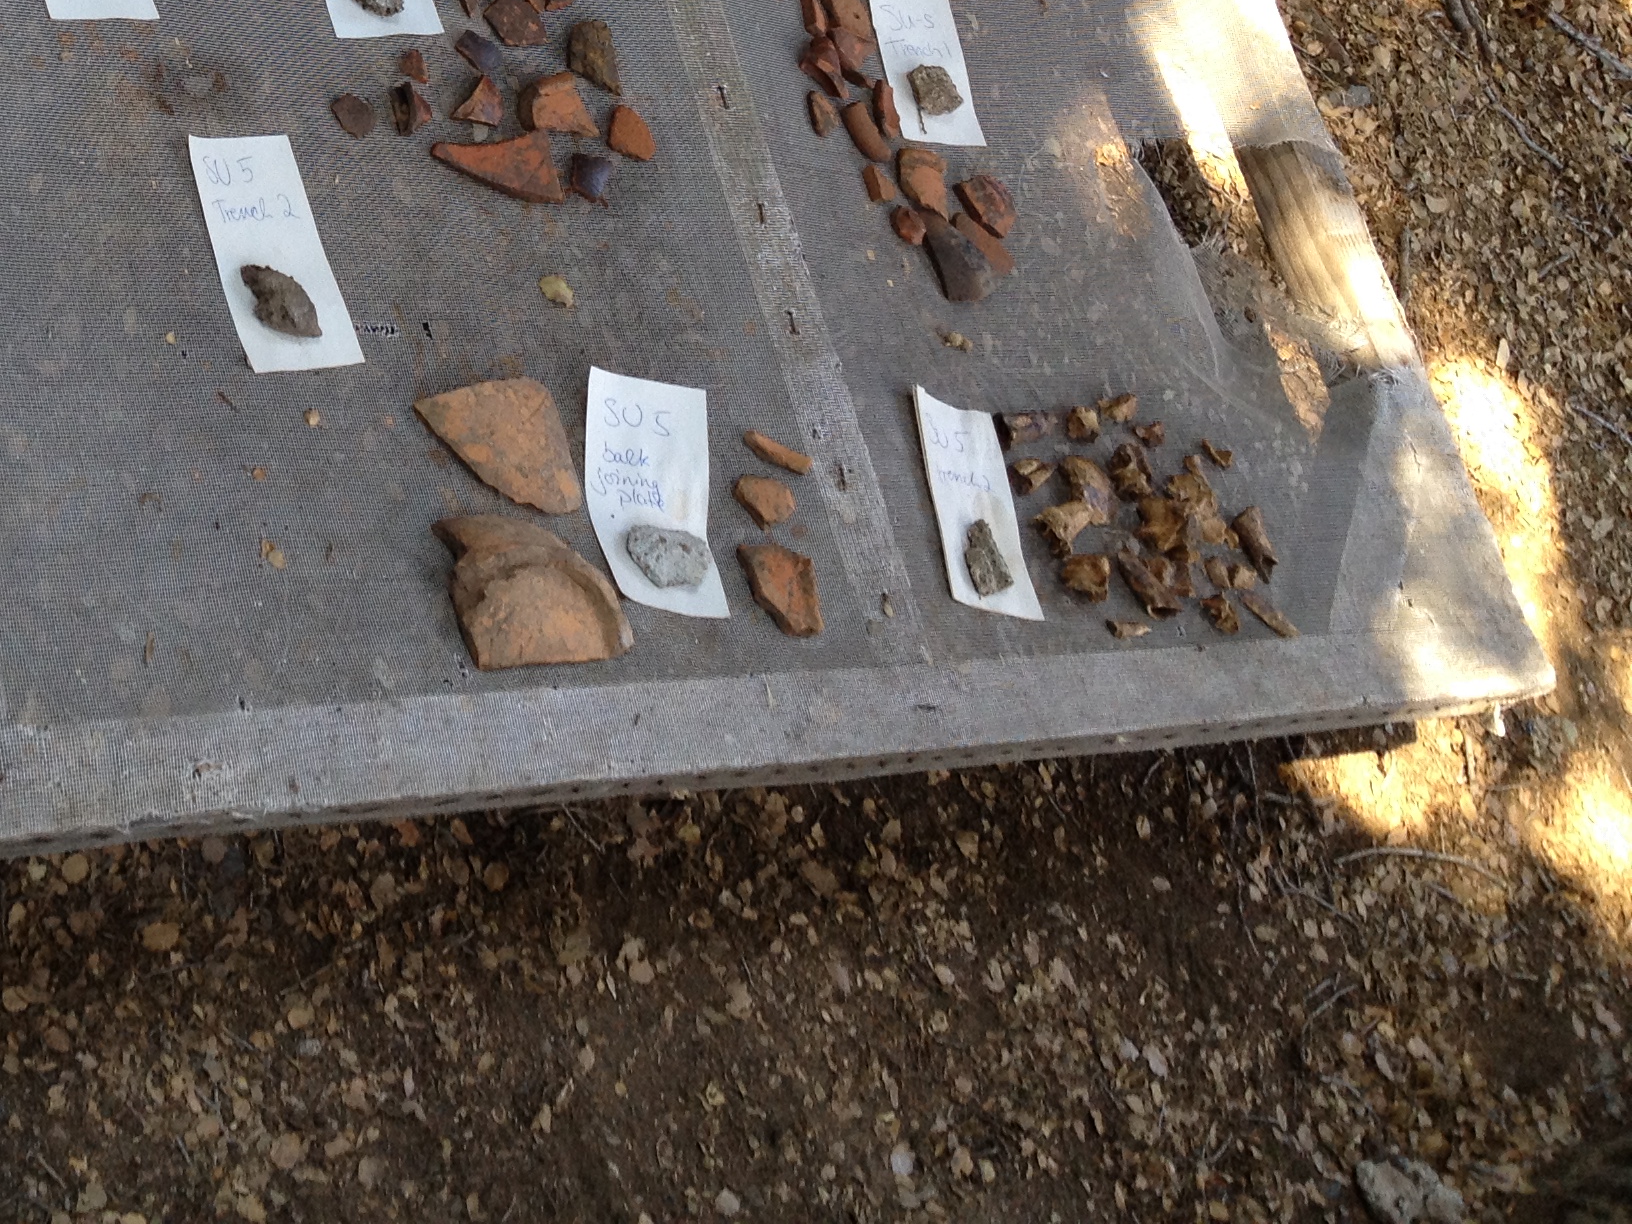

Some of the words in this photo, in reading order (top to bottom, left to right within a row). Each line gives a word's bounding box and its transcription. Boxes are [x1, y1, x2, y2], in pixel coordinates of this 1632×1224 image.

[202, 155, 232, 186] SU
[236, 156, 254, 184] 5
[212, 198, 273, 224] Trench
[277, 193, 301, 220] 2
[604, 398, 643, 428] SU
[652, 411, 671, 437] 5
[954, 431, 970, 453] 5
